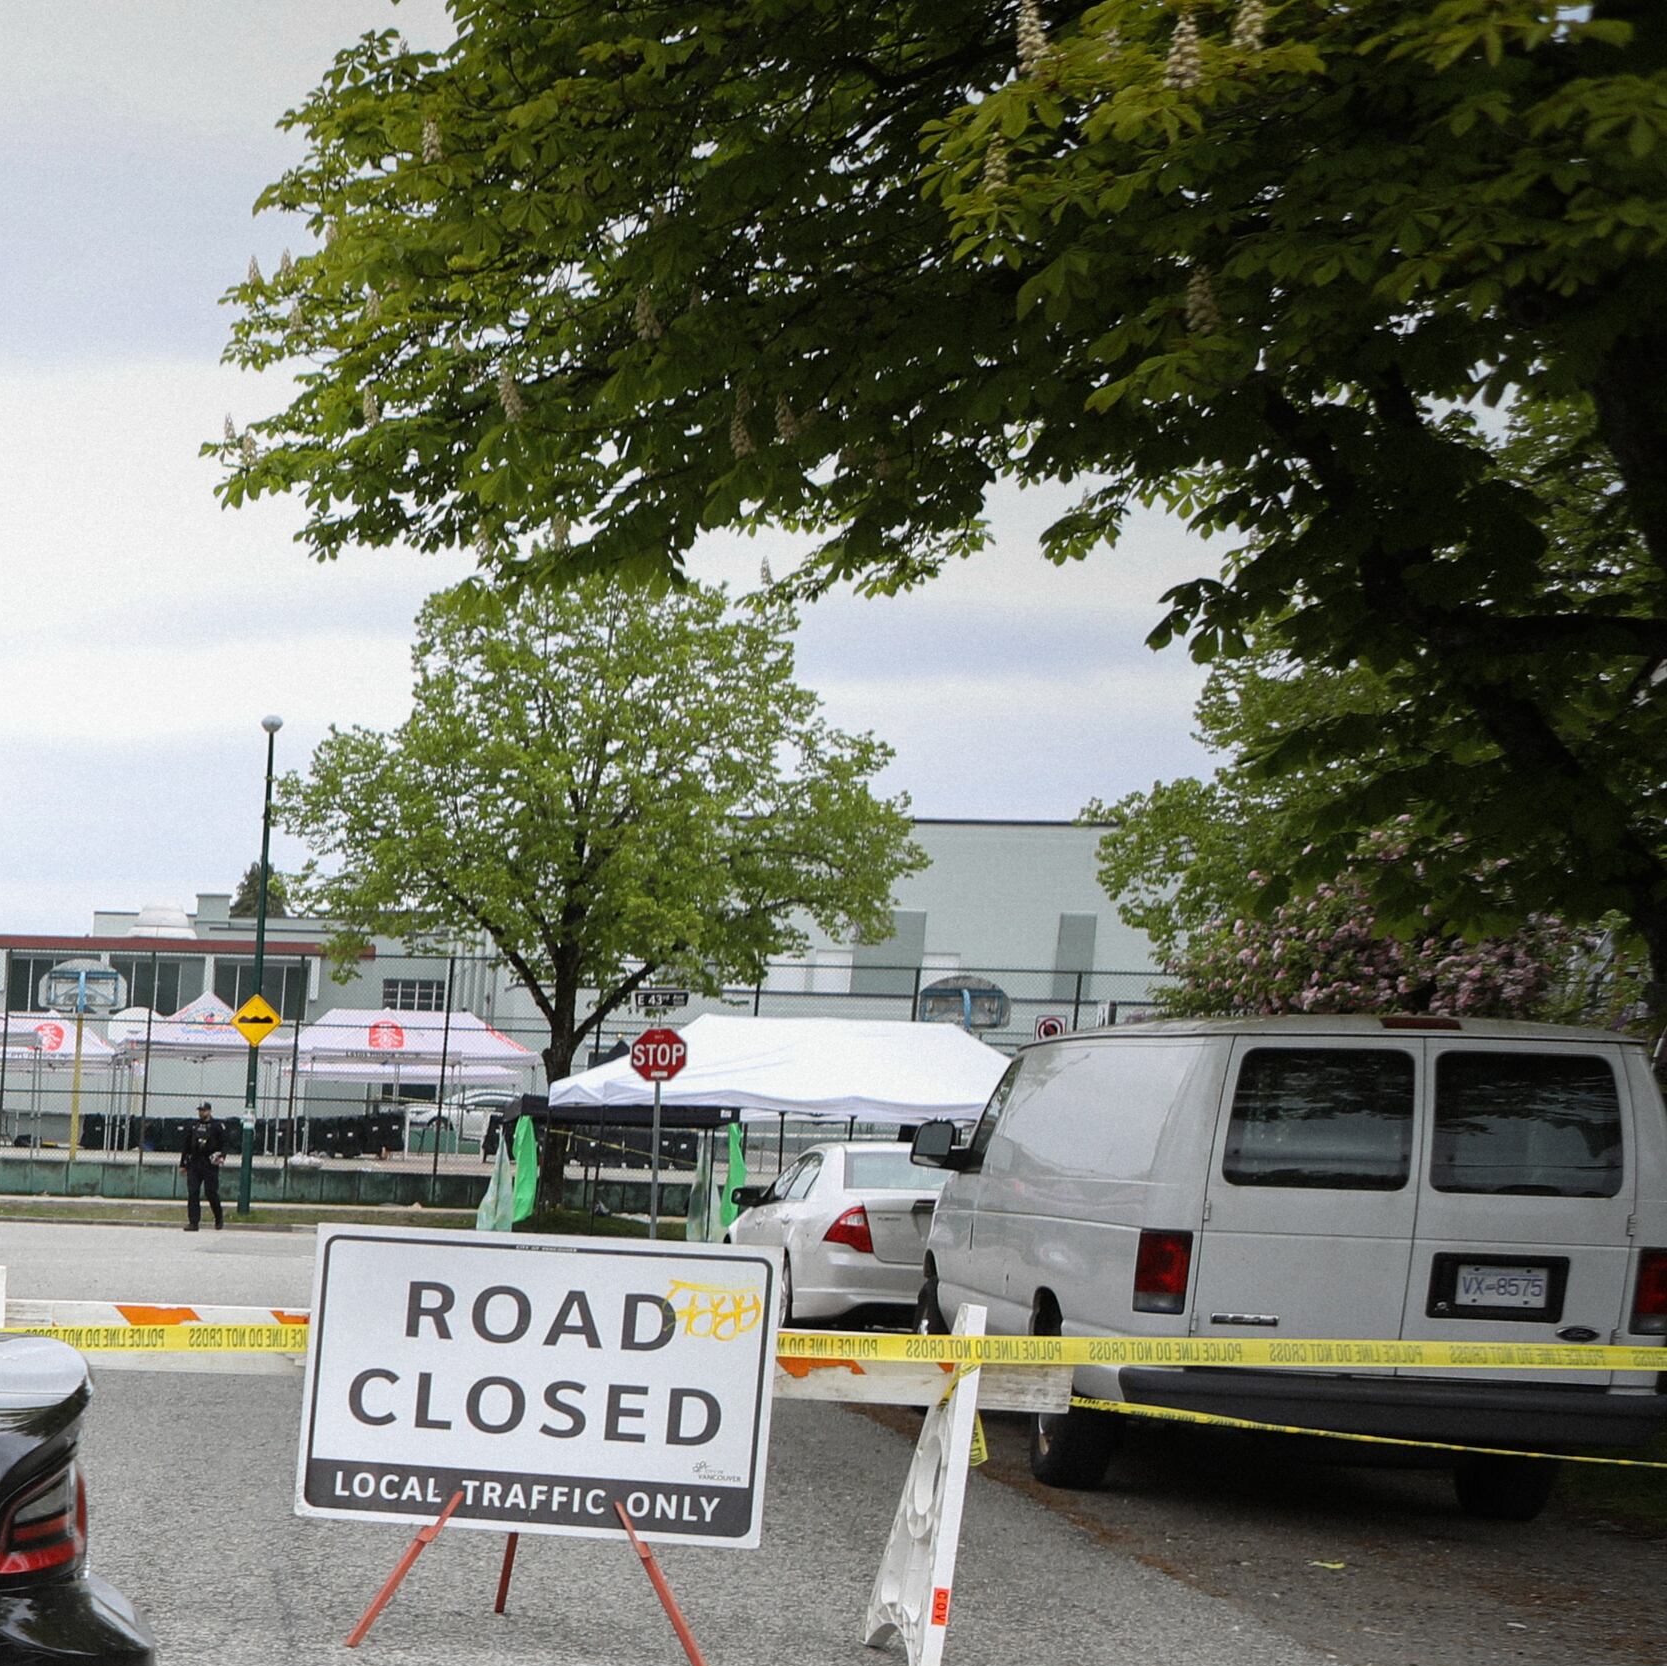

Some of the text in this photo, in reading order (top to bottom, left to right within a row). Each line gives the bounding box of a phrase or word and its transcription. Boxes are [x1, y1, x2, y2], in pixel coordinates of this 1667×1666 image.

[637, 994, 645, 1006] E
[633, 1043, 685, 1067] STOP
[404, 1280, 676, 1352] ROAD
[347, 1367, 723, 1446] CLOSED
[334, 1471, 721, 1524] LOCAL TRAFFIC ONLY
[935, 1591, 948, 1621] COV
